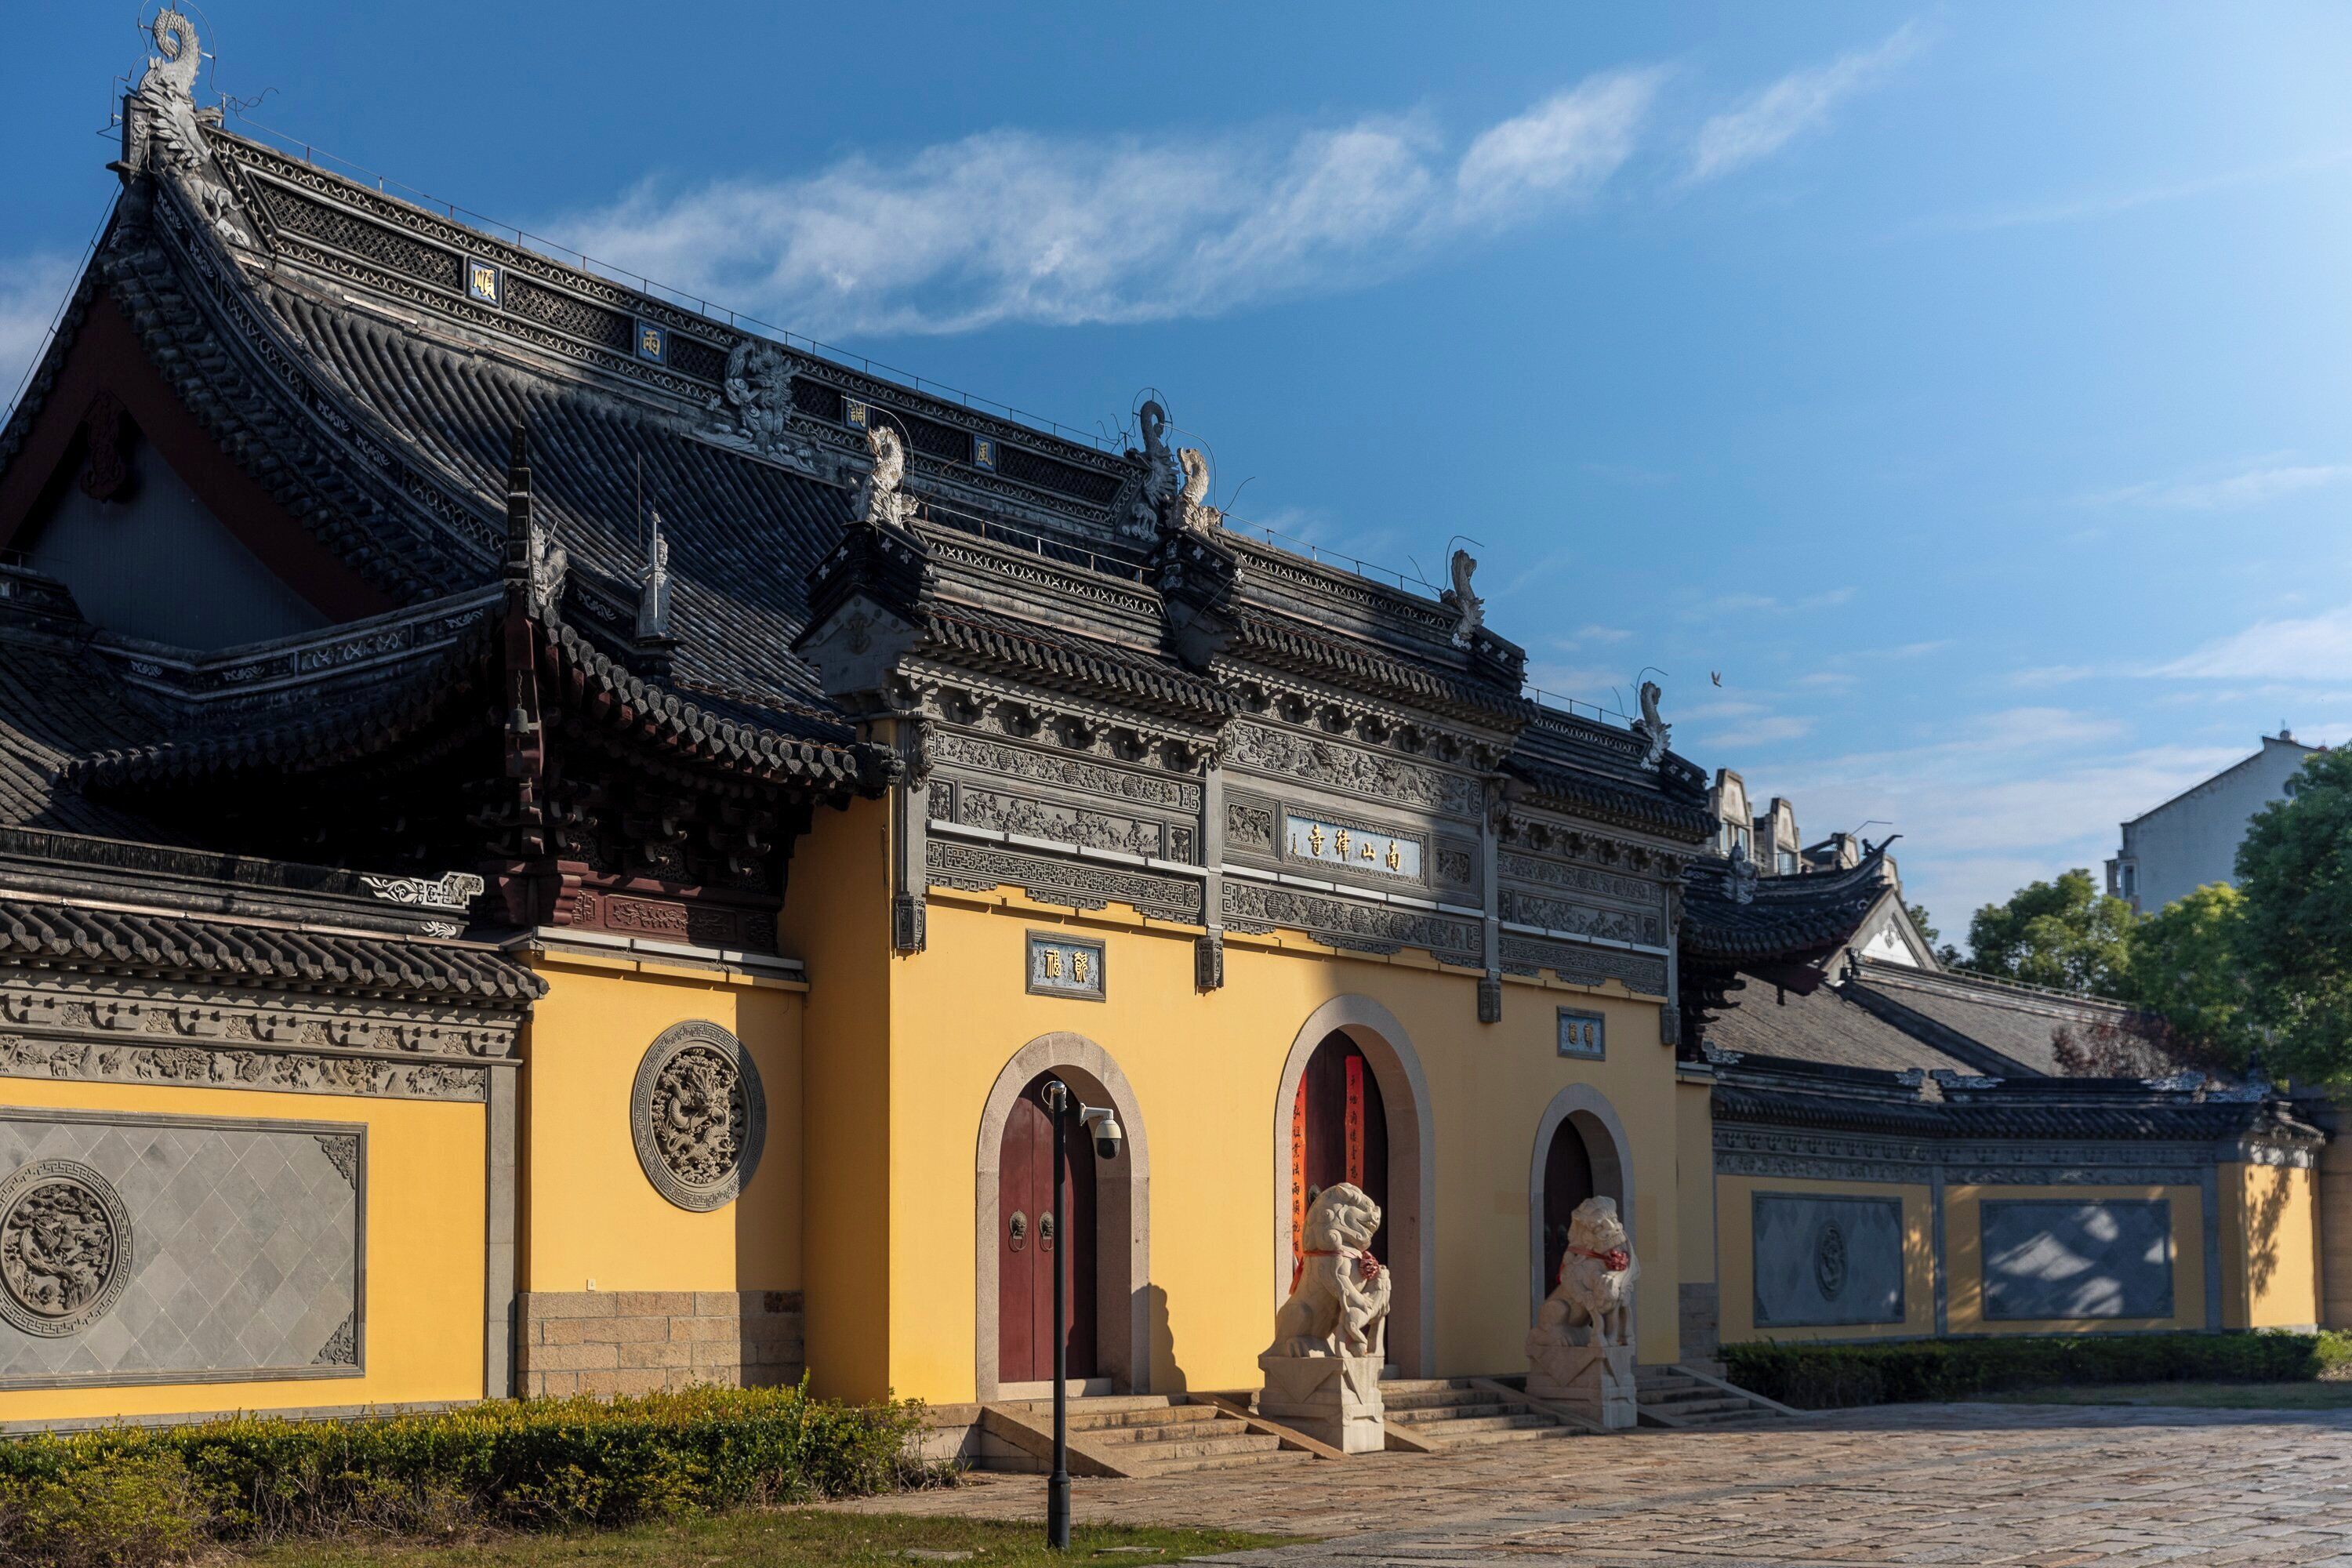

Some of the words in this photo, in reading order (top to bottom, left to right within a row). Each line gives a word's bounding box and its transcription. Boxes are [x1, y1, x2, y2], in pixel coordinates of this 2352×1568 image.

[474, 269, 497, 301] 順
[642, 329, 662, 357] 雨
[847, 397, 866, 428] 調
[977, 441, 993, 466] 風
